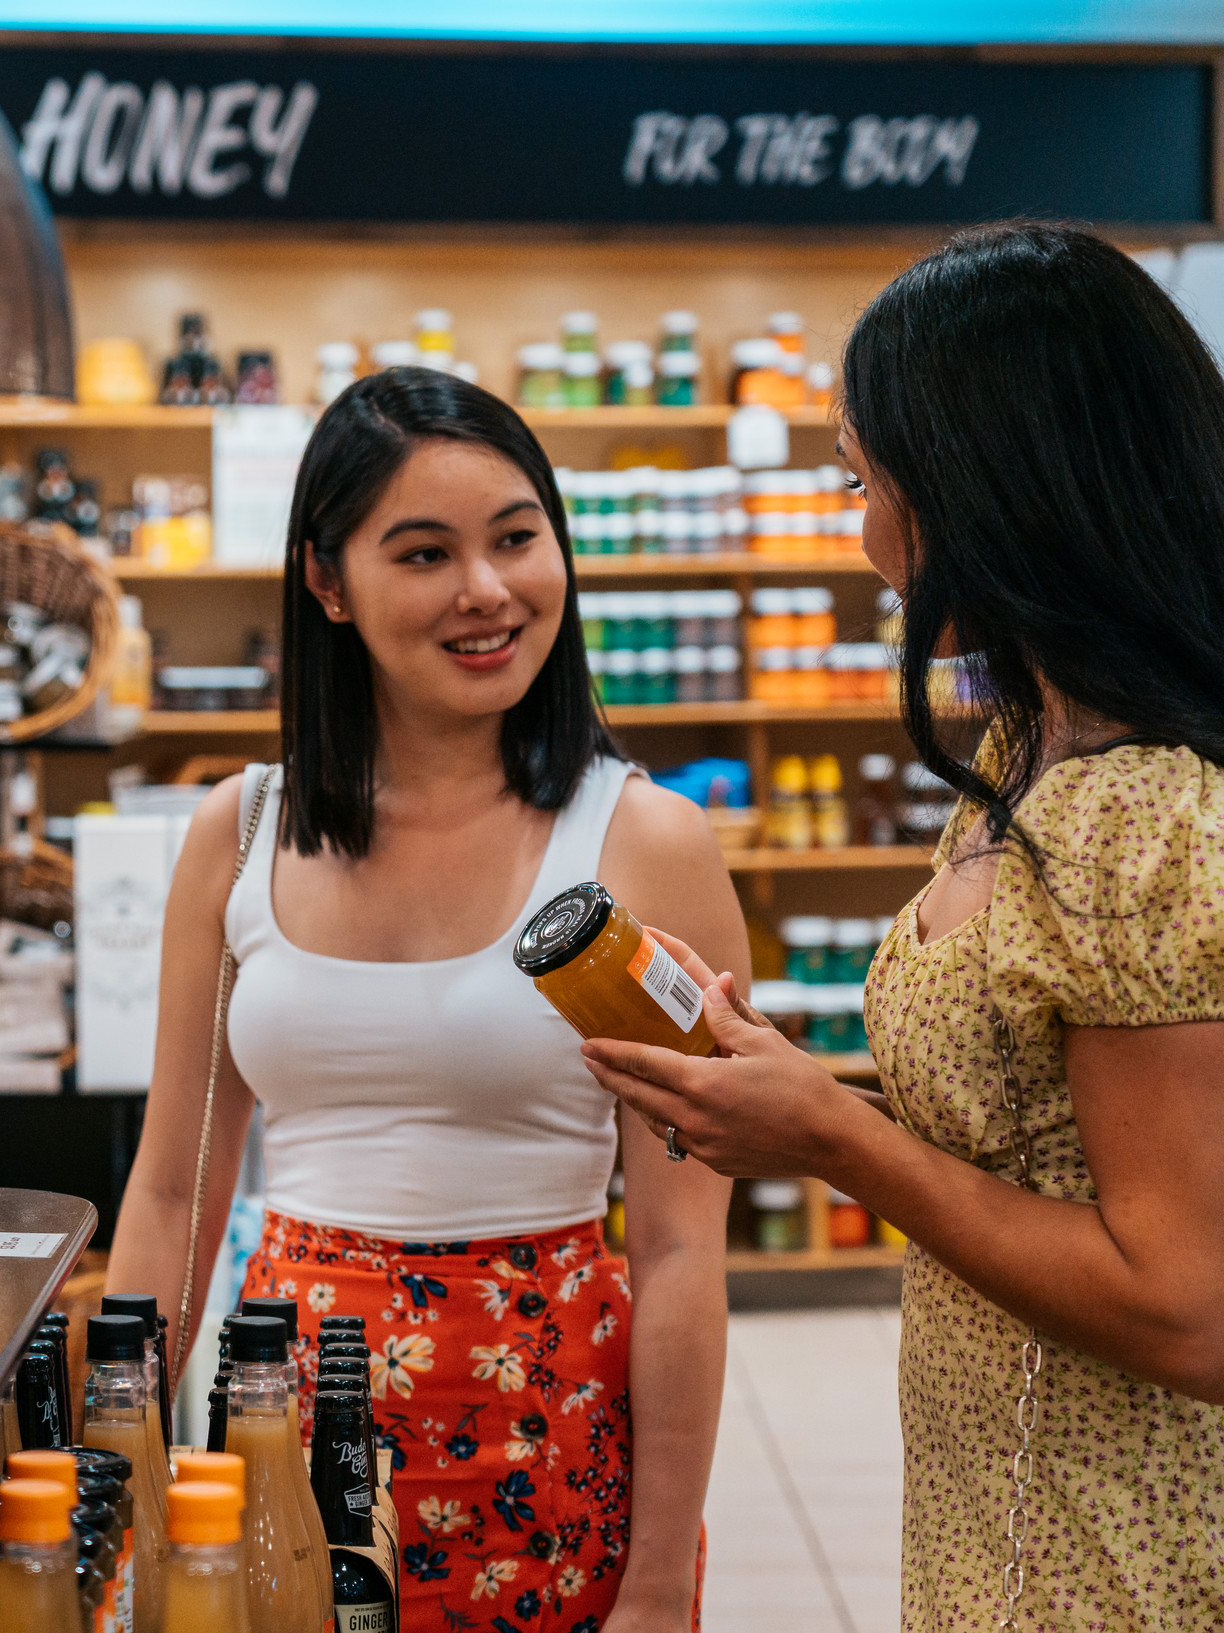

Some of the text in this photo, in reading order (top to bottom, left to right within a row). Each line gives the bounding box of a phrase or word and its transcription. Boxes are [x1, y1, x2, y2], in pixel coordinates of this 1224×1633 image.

[21, 71, 317, 198] HONEY
[624, 111, 978, 189] FOR THE BODY
